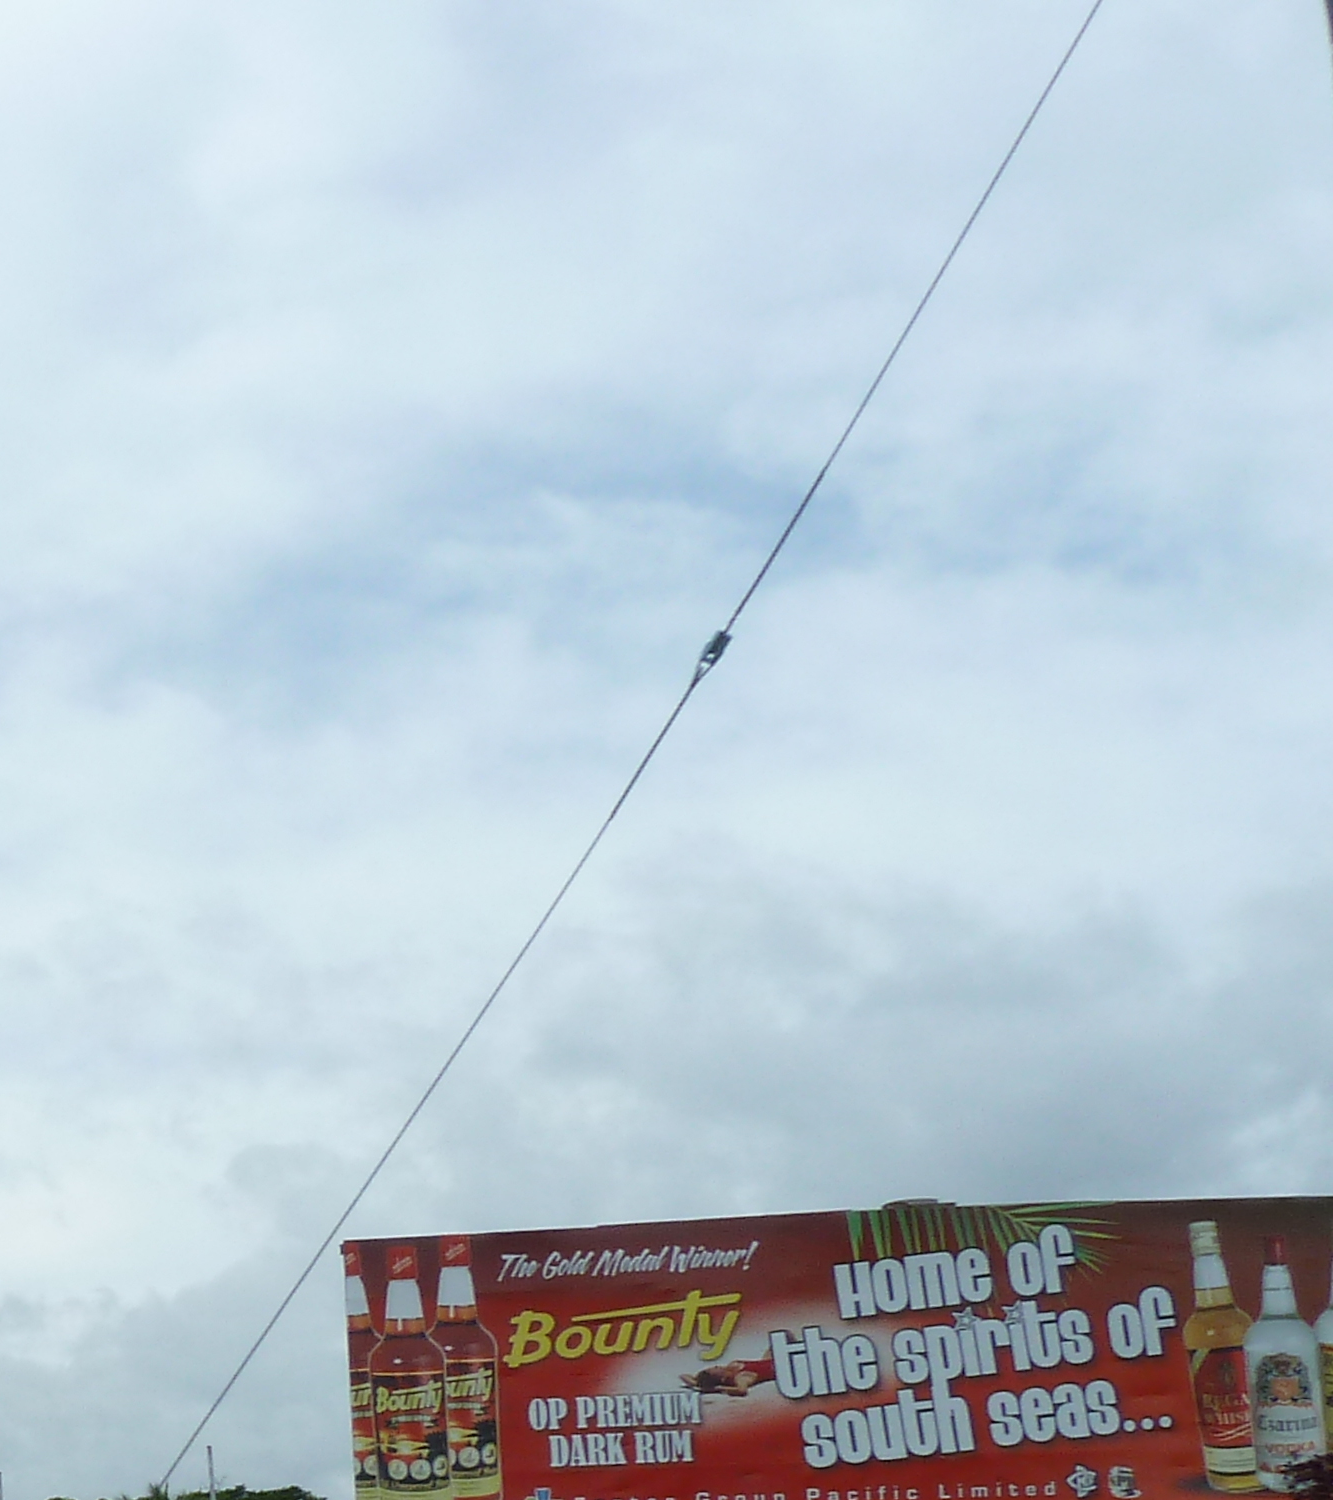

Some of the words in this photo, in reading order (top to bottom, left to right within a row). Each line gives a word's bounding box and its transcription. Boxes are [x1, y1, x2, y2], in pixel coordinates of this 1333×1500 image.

[497, 1253, 541, 1283] The
[541, 1250, 595, 1281] Gold
[590, 1246, 670, 1277] Medal
[667, 1240, 760, 1273] Winner!
[833, 1247, 993, 1319] Home
[1007, 1224, 1076, 1297] of
[502, 1289, 743, 1369] Bounty
[769, 1325, 879, 1400] the
[892, 1299, 1095, 1390] spirits
[1106, 1286, 1177, 1360] of
[375, 1379, 444, 1414] Bounty
[528, 1397, 569, 1432] OP
[575, 1391, 703, 1430] PREMIUM
[800, 1385, 976, 1469] south
[987, 1379, 1174, 1448] seas...
[549, 1432, 629, 1469] DARK
[635, 1429, 695, 1465] RUM
[938, 1480, 1057, 1500] Limited
